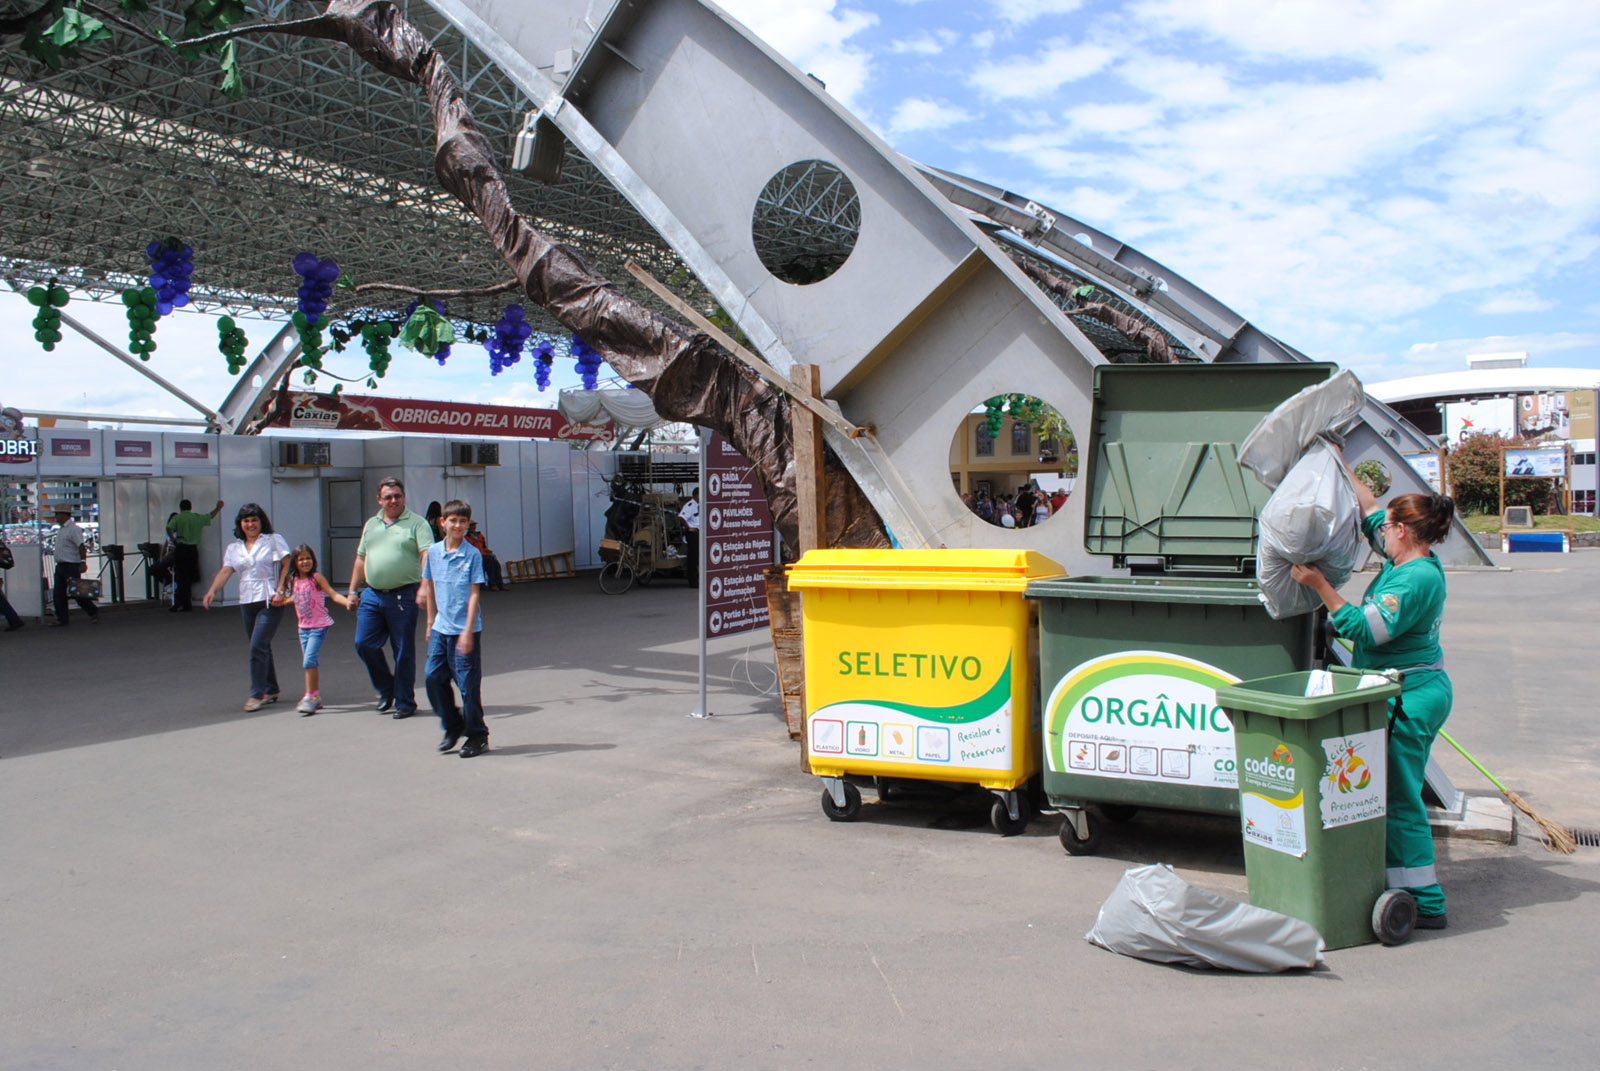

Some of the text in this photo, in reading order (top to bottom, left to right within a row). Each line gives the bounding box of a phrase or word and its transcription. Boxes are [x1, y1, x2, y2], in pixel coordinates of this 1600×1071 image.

[294, 408, 338, 420] Caxias
[391, 407, 552, 430] OBRIGADO PELA VISITA
[722, 471, 740, 481] SAÍDA
[723, 506, 753, 517] PAVILHÕES
[723, 519, 762, 528] Acesso Principal
[723, 541, 744, 552] Estação
[752, 540, 771, 550] Réplica
[731, 553, 749, 561] Caxias
[724, 575, 745, 586] Estação
[724, 586, 756, 597] Informações
[723, 609, 741, 620] Portão
[838, 651, 982, 681] SELETIVO
[957, 727, 992, 743] Reciclar
[1068, 732, 1098, 740] DEPOSITE
[960, 744, 1007, 761] Preservar
[1244, 756, 1295, 781] codeca
[1331, 793, 1379, 812] Preservando
[1330, 812, 1349, 823] meio
[1351, 804, 1385, 820] ambiente
[1245, 825, 1273, 842] Caxias
